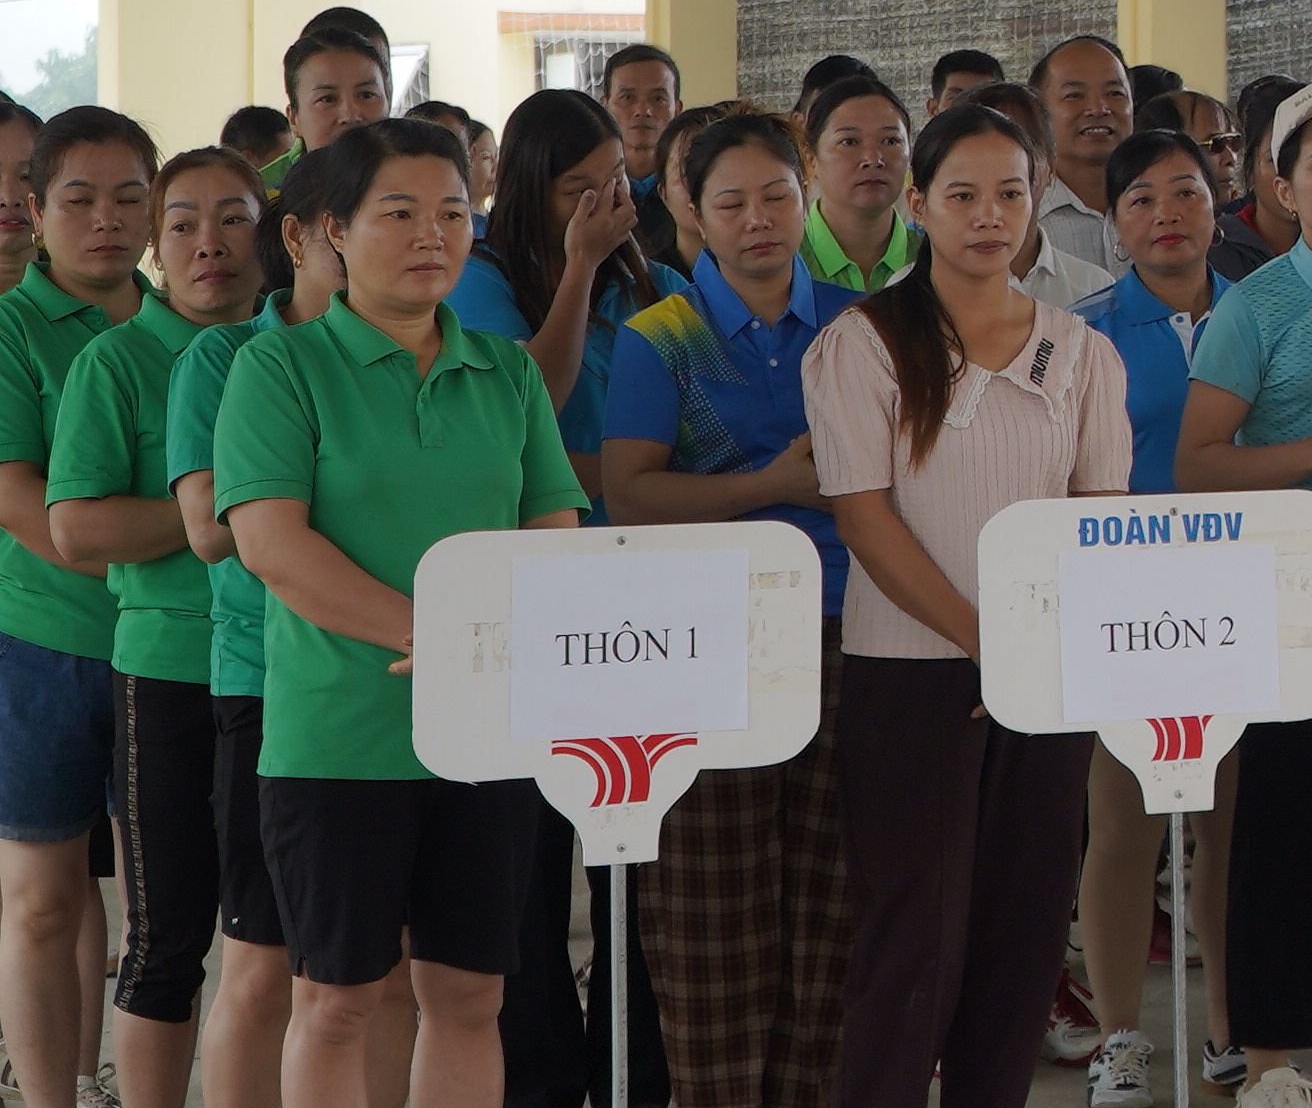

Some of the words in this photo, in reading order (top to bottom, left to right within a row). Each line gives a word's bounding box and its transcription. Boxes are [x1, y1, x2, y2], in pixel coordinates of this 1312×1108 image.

[1077, 508, 1171, 547] ĐOÀN
[1182, 511, 1243, 544] VĐV
[554, 620, 672, 667] THÔN
[687, 626, 700, 660] 1
[1100, 610, 1208, 654] THÔN
[1218, 616, 1238, 647] 2
